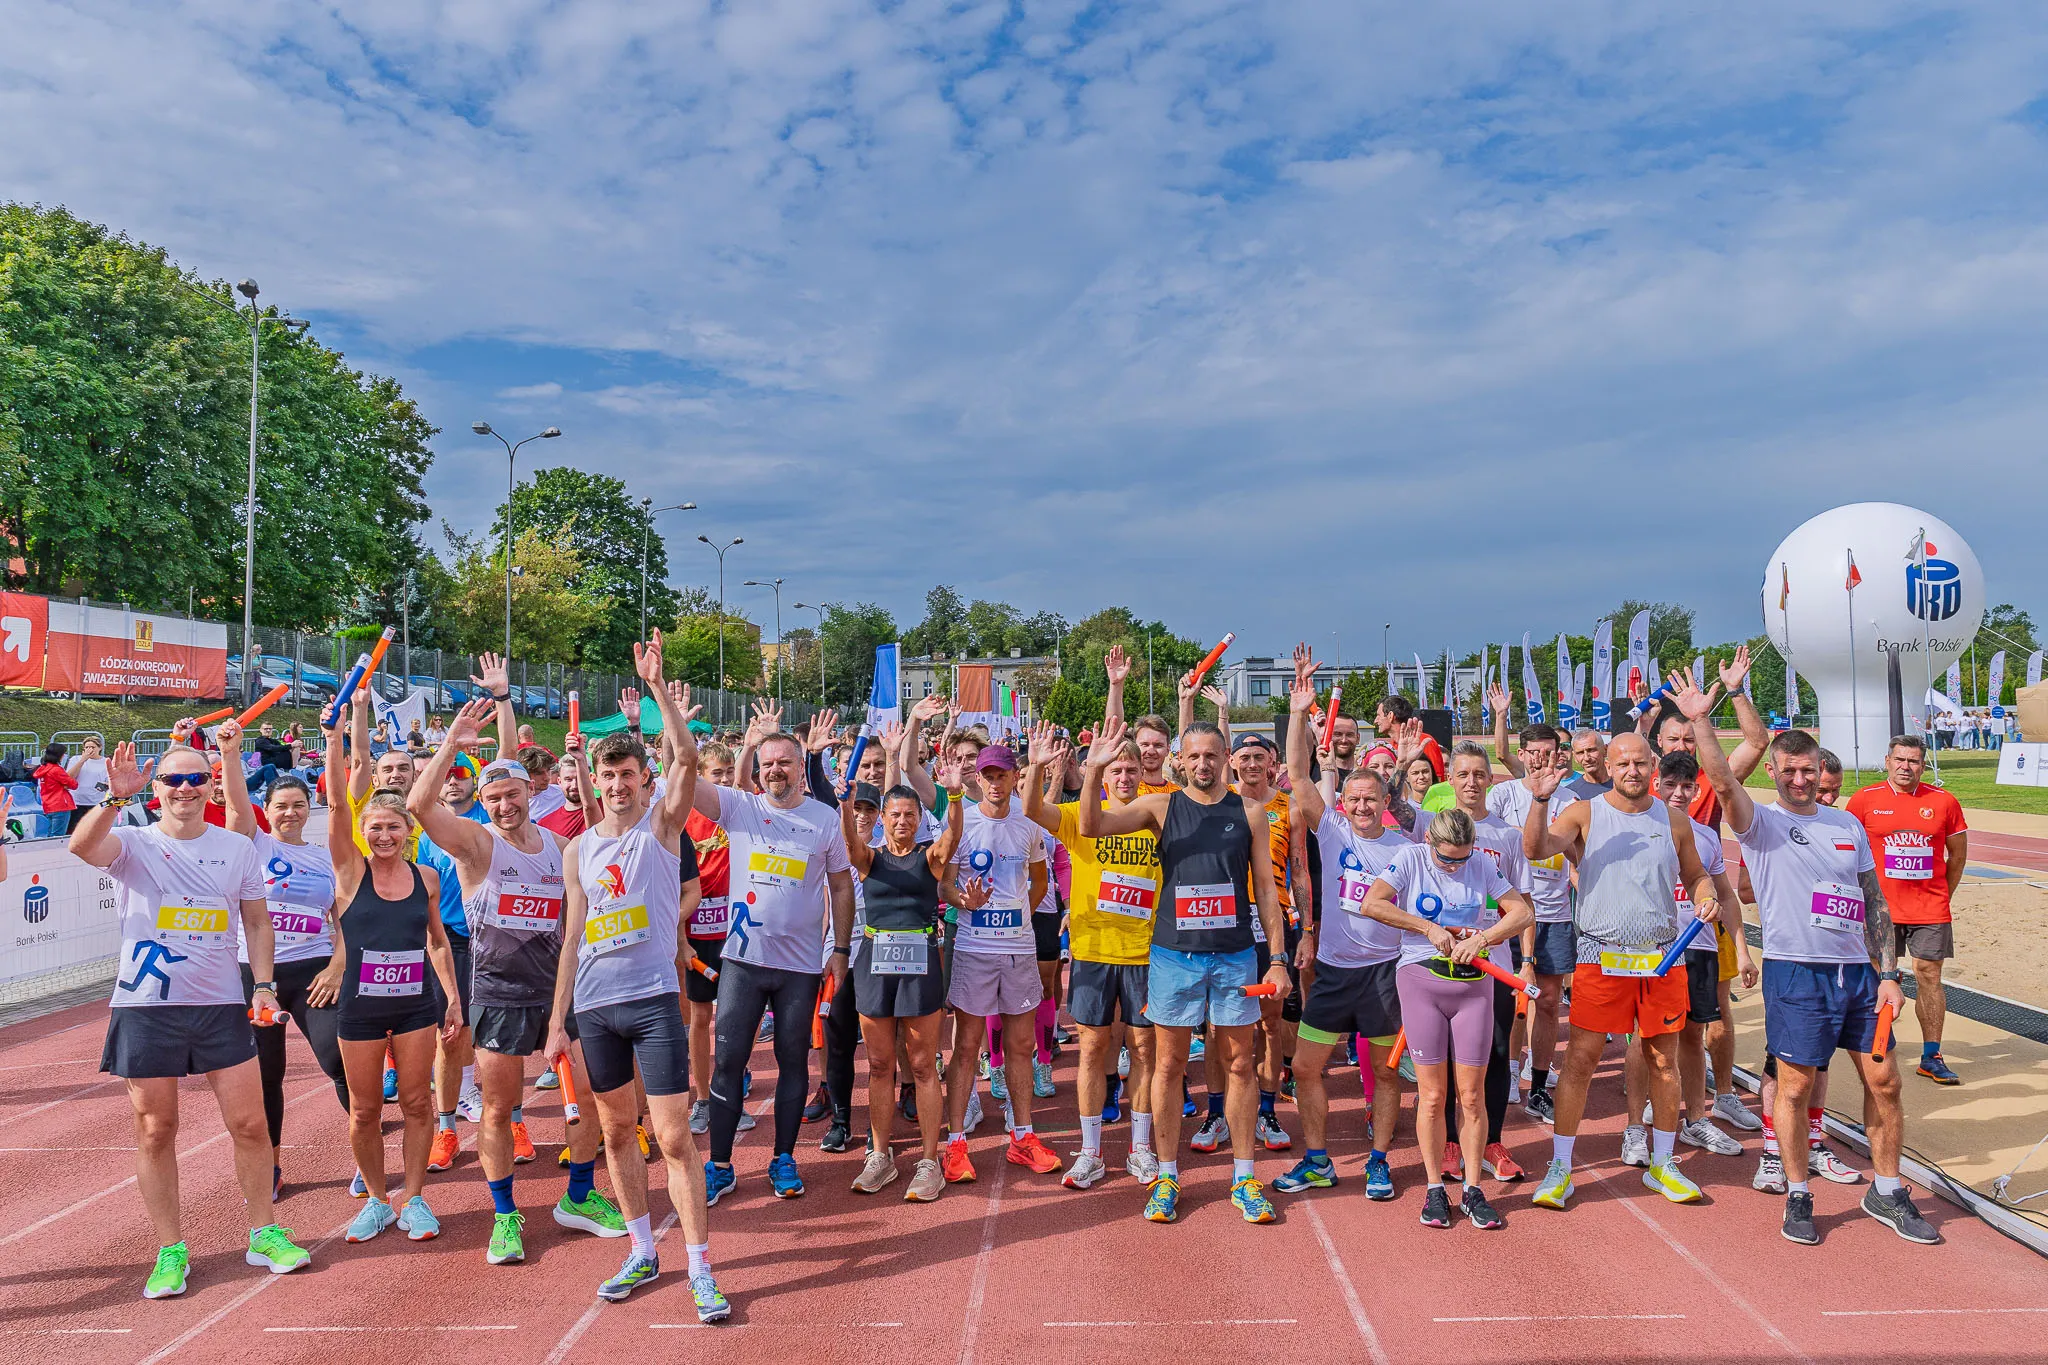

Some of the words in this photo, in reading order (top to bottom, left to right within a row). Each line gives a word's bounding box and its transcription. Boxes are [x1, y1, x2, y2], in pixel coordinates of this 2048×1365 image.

[1877, 638, 1921, 653] Bank
[1925, 638, 1965, 652] Polski
[134, 660, 184, 674] OKRĘGOWY
[83, 672, 127, 687] ZWIĄZEK
[127, 674, 159, 687] LEKKIEJ
[160, 677, 199, 690] ATLETYKI
[1095, 835, 1158, 852] FORTUN
[765, 857, 789, 874] 7/1
[1894, 857, 1924, 870] 30/1
[99, 898, 116, 910] raz
[1110, 886, 1142, 905] 17/1
[512, 898, 549, 917] 52/1
[1187, 899, 1222, 915] 45/1
[1826, 897, 1859, 919] 58/1
[173, 911, 217, 929] 56/1
[272, 914, 308, 931] 51/1
[697, 909, 725, 923] 65/1
[982, 912, 1012, 926] 18/1
[594, 911, 634, 939] 35/1
[16, 935, 36, 947] Bank
[37, 930, 59, 942] Polski
[882, 946, 915, 961] 78/1
[1612, 955, 1649, 969] 77/1
[373, 966, 411, 983] 86/1
